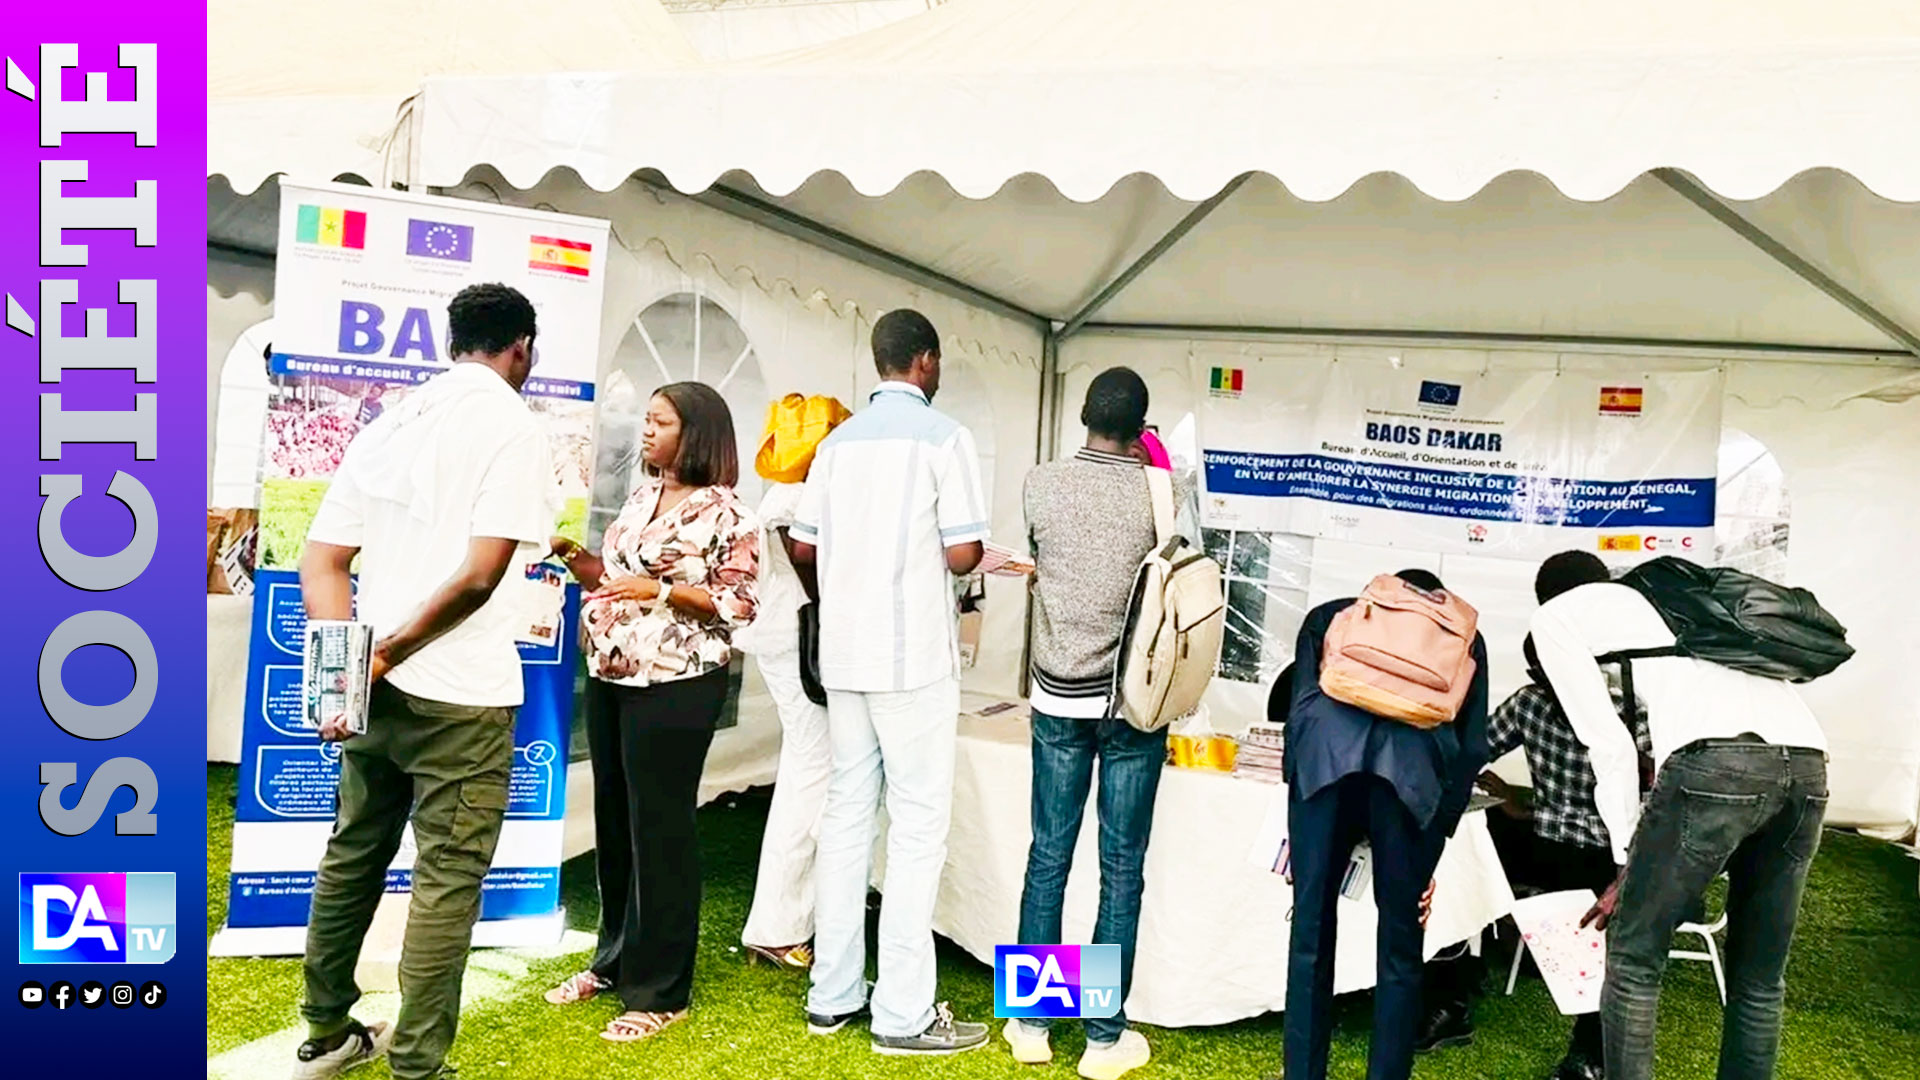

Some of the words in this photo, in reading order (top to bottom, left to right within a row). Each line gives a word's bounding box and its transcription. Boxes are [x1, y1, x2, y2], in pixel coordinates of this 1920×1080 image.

[338, 299, 440, 362] BA
[286, 358, 340, 374] Bureau
[1366, 421, 1421, 445] BAOS
[1426, 427, 1503, 453] DAKAR
[1412, 452, 1486, 470] d'Orientation
[1489, 460, 1501, 469] et
[1504, 460, 1518, 470] de
[1203, 453, 1290, 469] RENFORCEMENT
[1291, 458, 1305, 468] DE
[1307, 458, 1322, 470] LA
[1323, 461, 1412, 481] GOUVERNANCE
[1414, 471, 1483, 488] INCLUSIVE
[1486, 478, 1504, 490] DE
[1609, 486, 1627, 496] AU
[1630, 483, 1697, 496] SENEGAL,
[1234, 468, 1250, 479] EN
[1252, 470, 1275, 481] VUE
[1353, 479, 1369, 490] LA
[1371, 481, 1432, 497] SYNERGIE
[1435, 488, 1514, 504] MIGRATION
[1332, 491, 1356, 501] pour
[1357, 493, 1374, 504] des
[534, 745, 545, 760] 7
